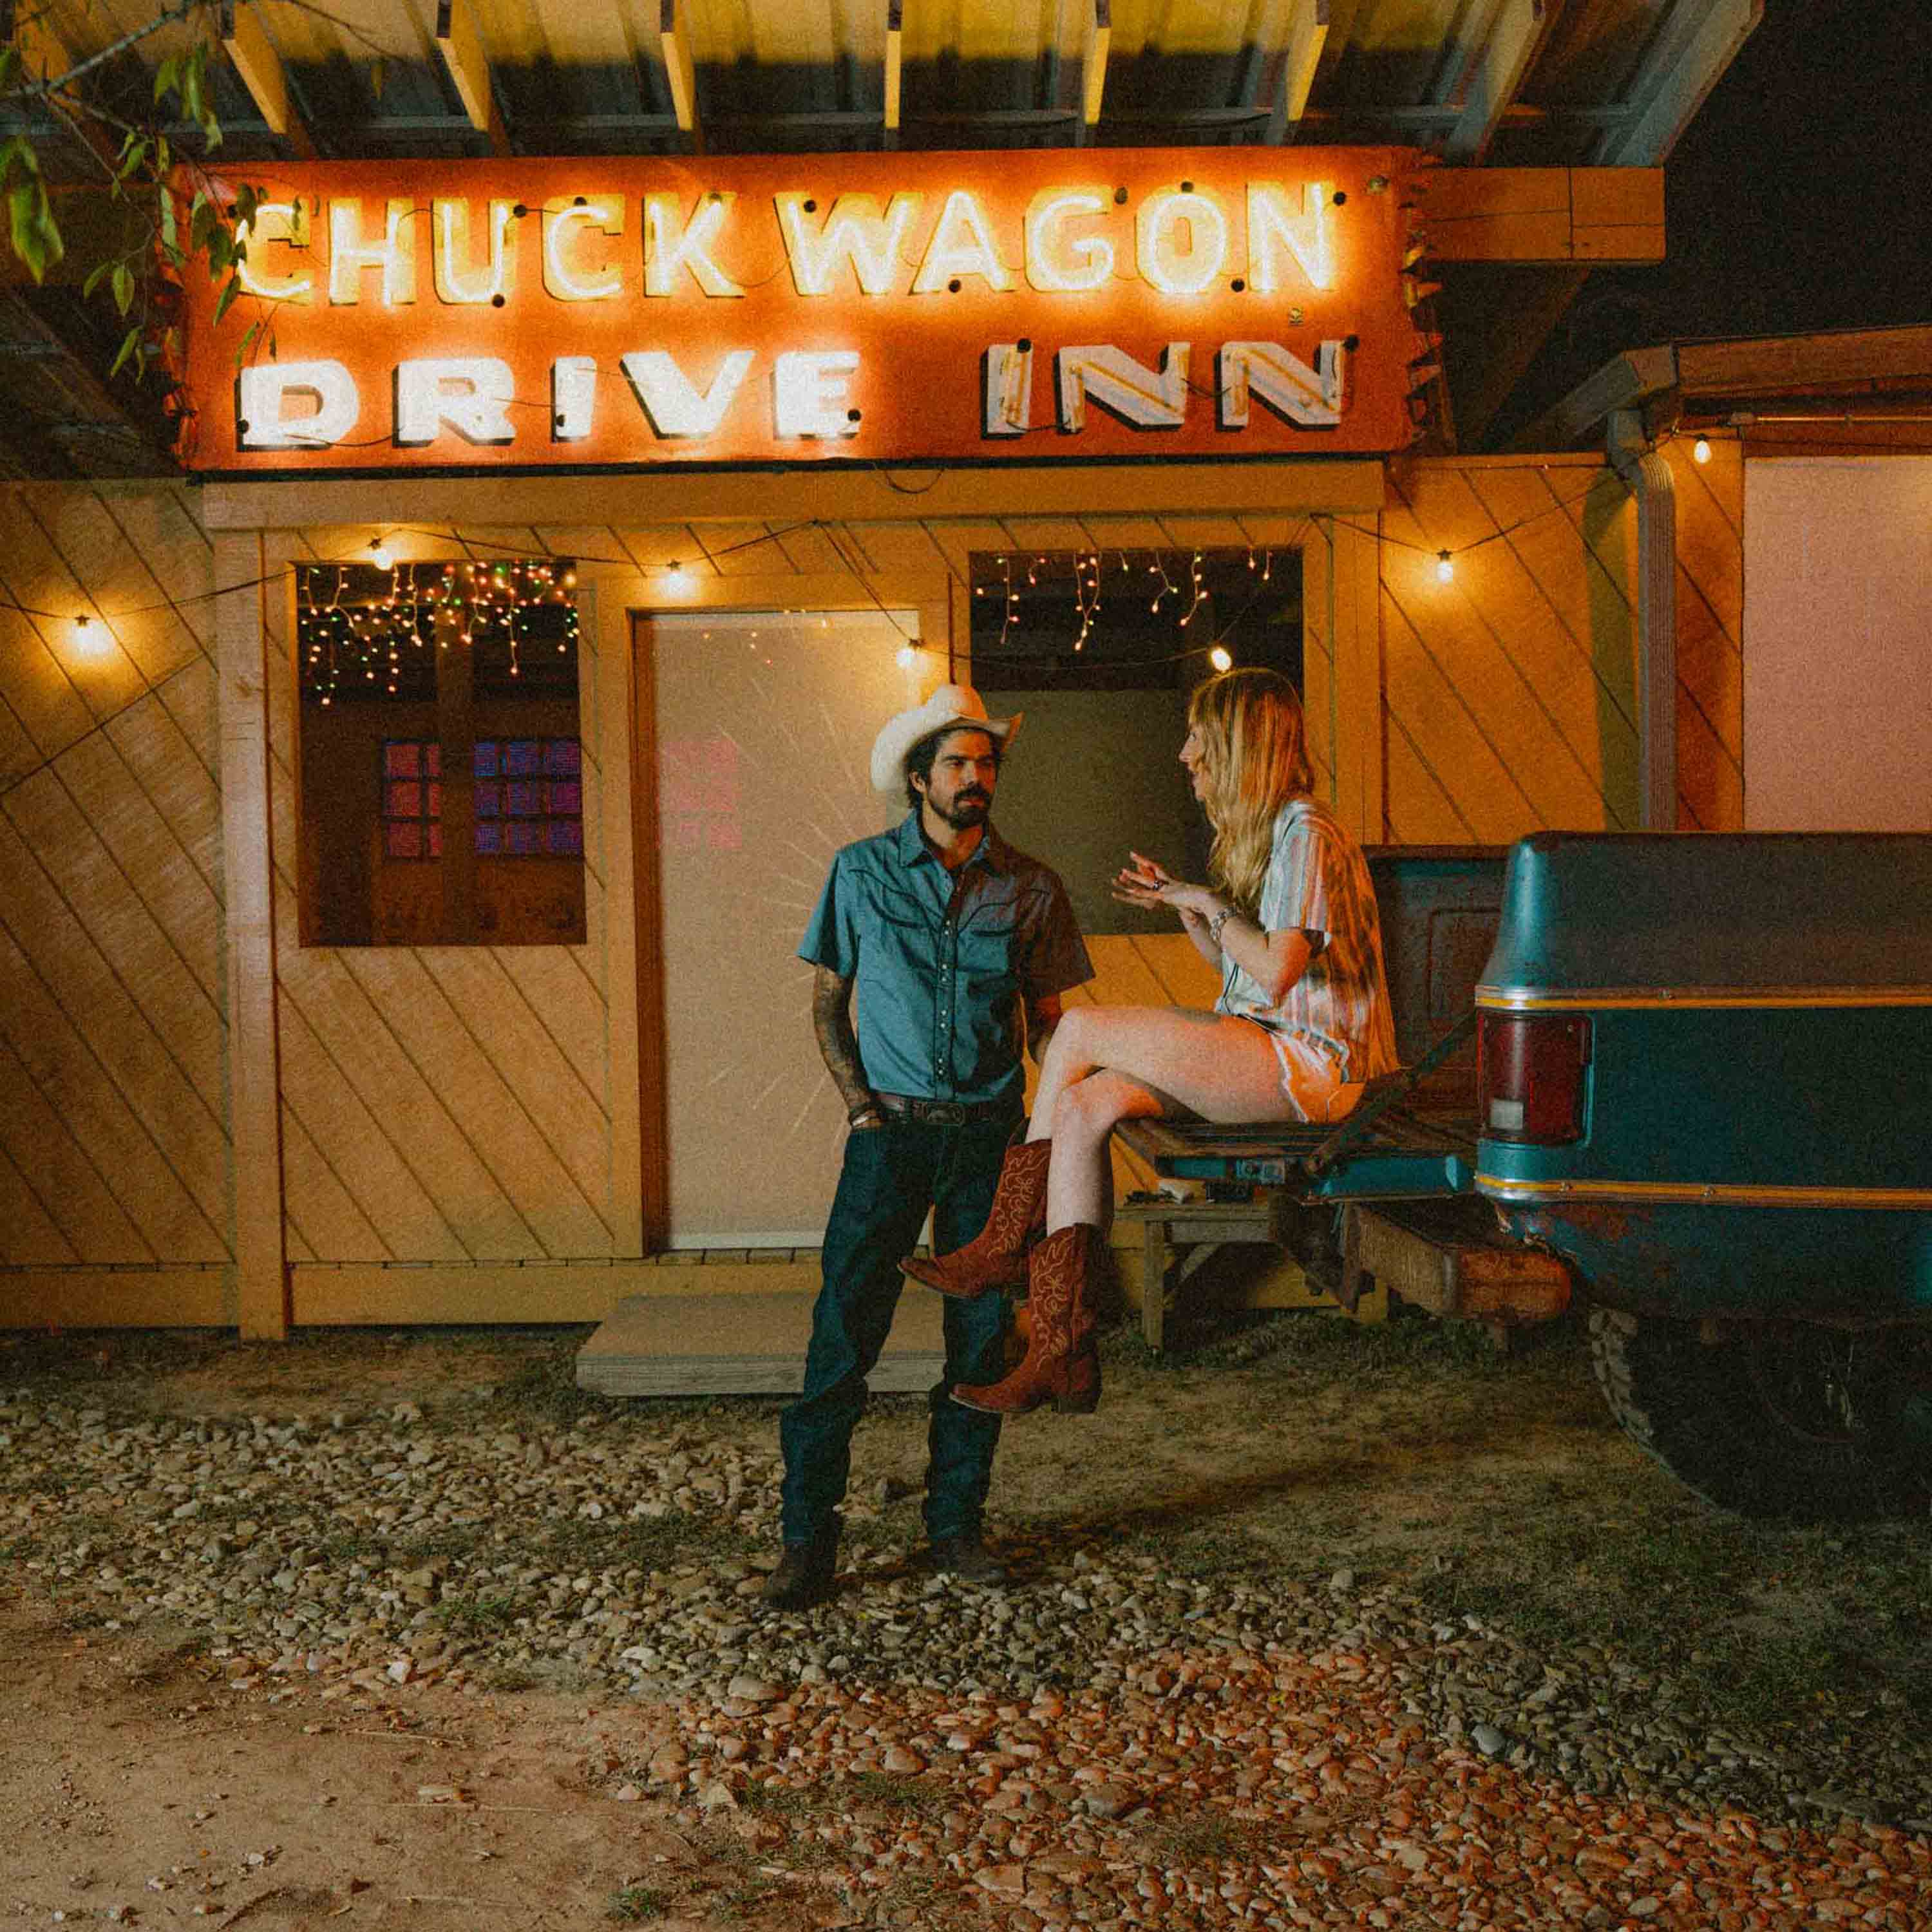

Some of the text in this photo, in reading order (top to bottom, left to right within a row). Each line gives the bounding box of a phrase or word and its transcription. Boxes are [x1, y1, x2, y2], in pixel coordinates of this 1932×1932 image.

[239, 180, 1337, 306] CHUCK WAGON
[237, 340, 1344, 451] DRIVE INN
